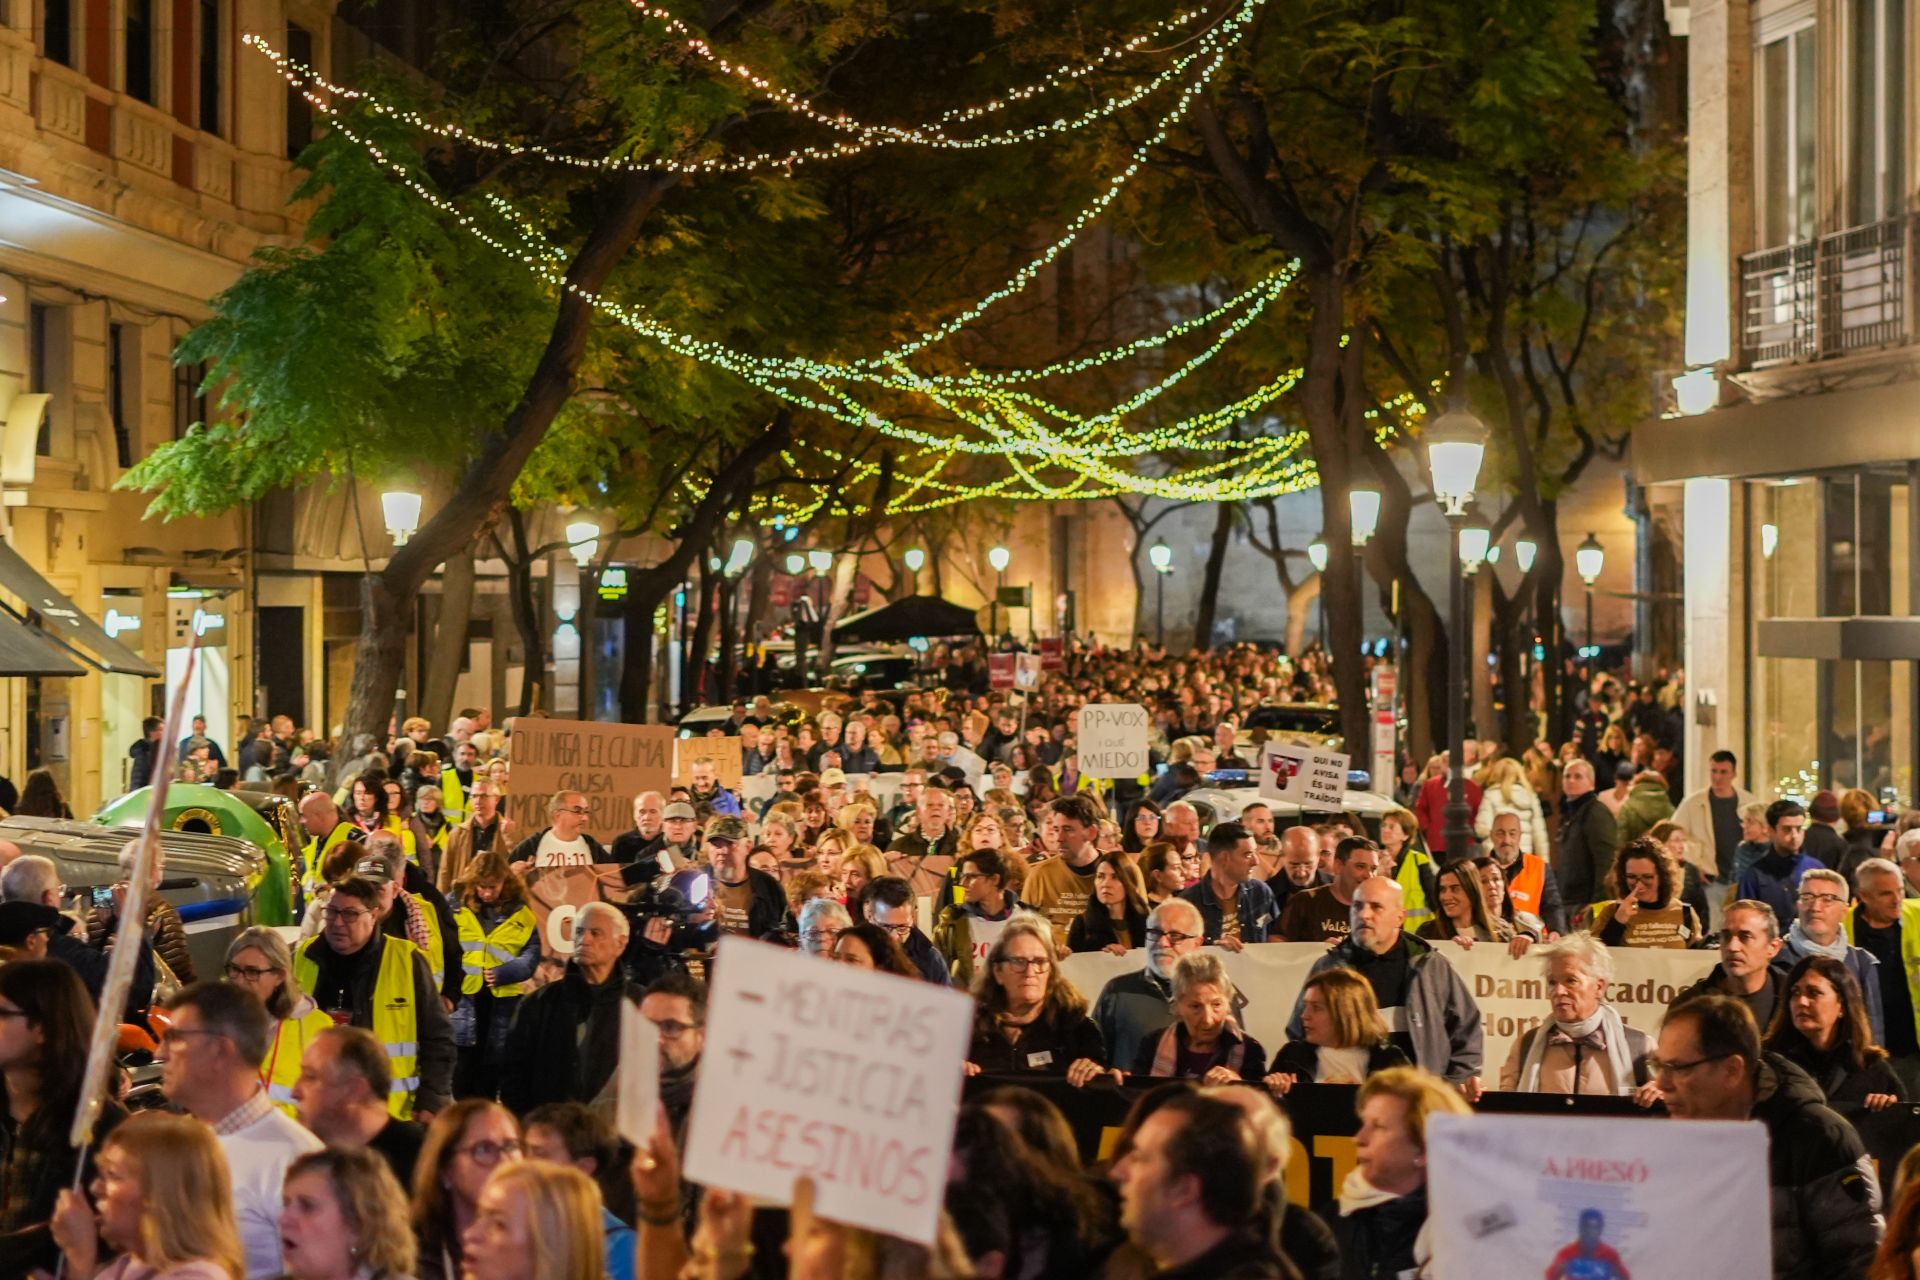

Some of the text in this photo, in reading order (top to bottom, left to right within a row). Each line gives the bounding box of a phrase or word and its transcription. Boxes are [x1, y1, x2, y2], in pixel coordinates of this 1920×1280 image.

[512, 730, 544, 765] QUI
[547, 732, 581, 767] NEGA
[588, 734, 605, 768] EL
[607, 735, 665, 768] CLIMA
[1080, 751, 1145, 769] MIEDO!
[1313, 756, 1343, 768] QUI NO
[557, 771, 615, 793] CAUSA
[1313, 769, 1339, 780] AVISA
[1325, 782, 1338, 791] UN
[510, 793, 554, 828] MOR
[720, 1105, 933, 1206] ASESINOS
